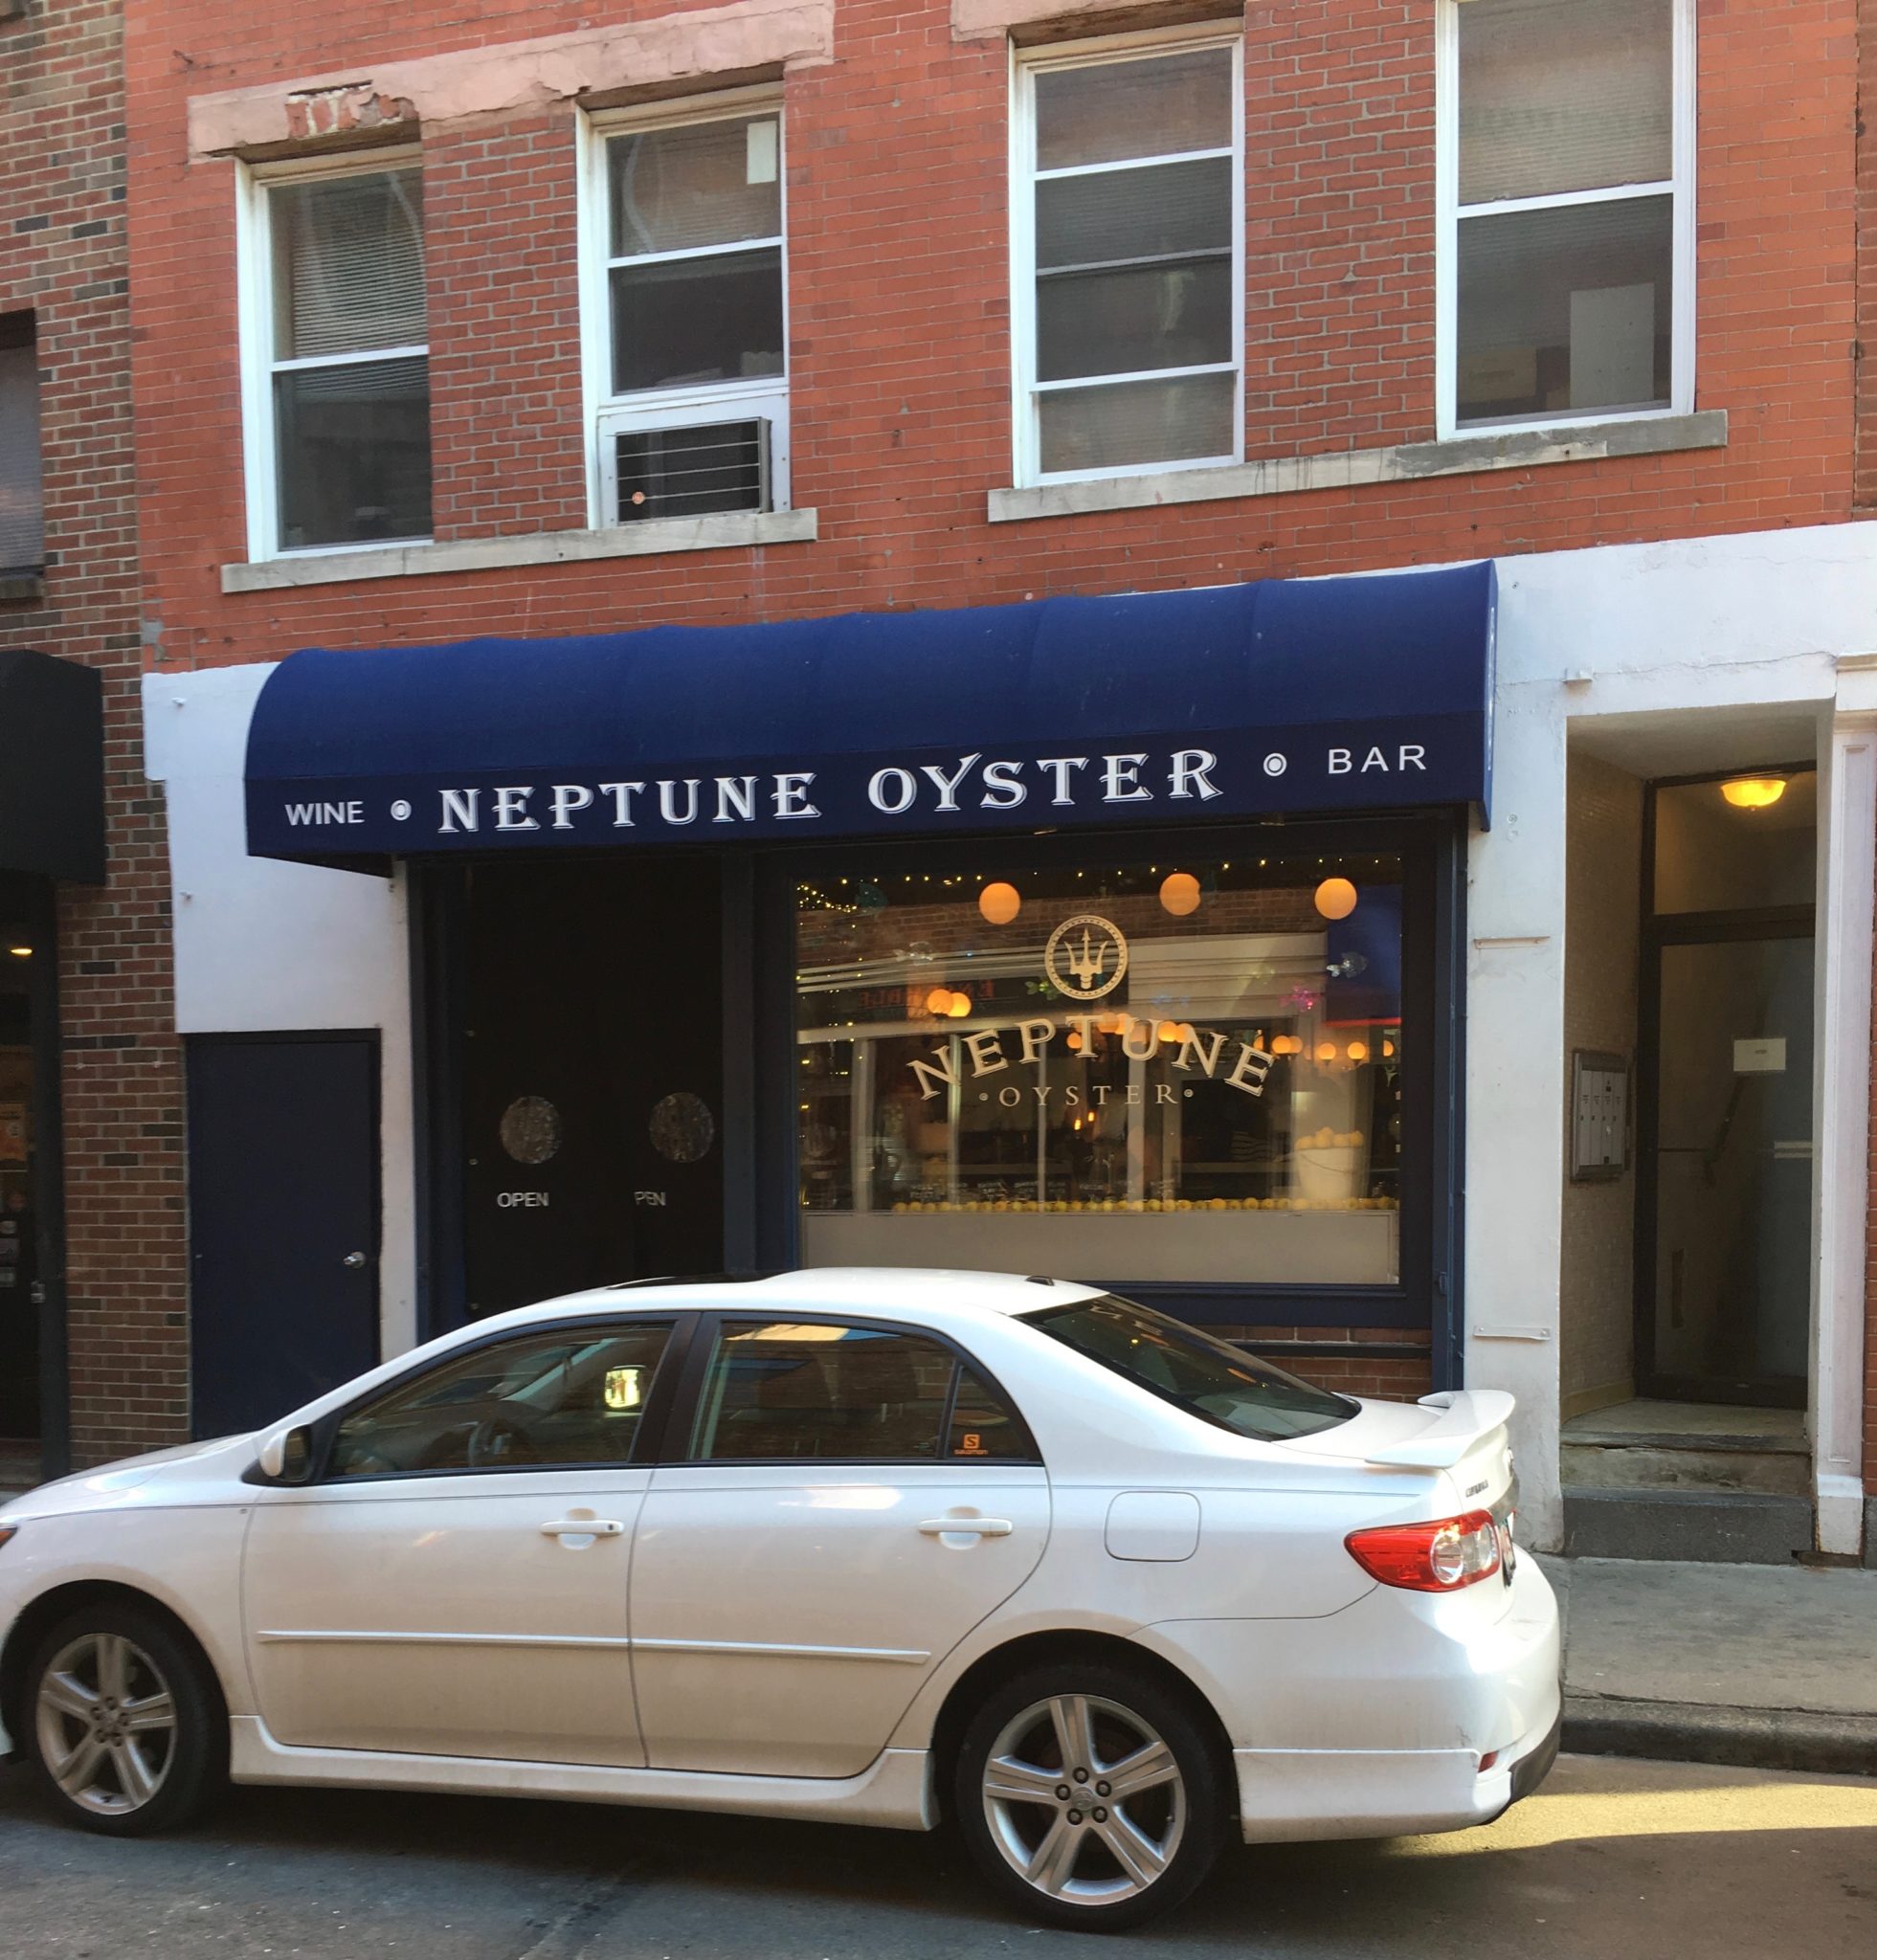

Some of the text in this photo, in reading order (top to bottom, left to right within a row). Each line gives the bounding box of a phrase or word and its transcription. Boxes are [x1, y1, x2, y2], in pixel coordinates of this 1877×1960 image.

[284, 745, 1427, 834] WINE NEPTUNE OYSTER BAR
[906, 1014, 1274, 1098] NEPTUNE
[998, 1083, 1178, 1108] OYSTER
[496, 1192, 549, 1208] OPEN
